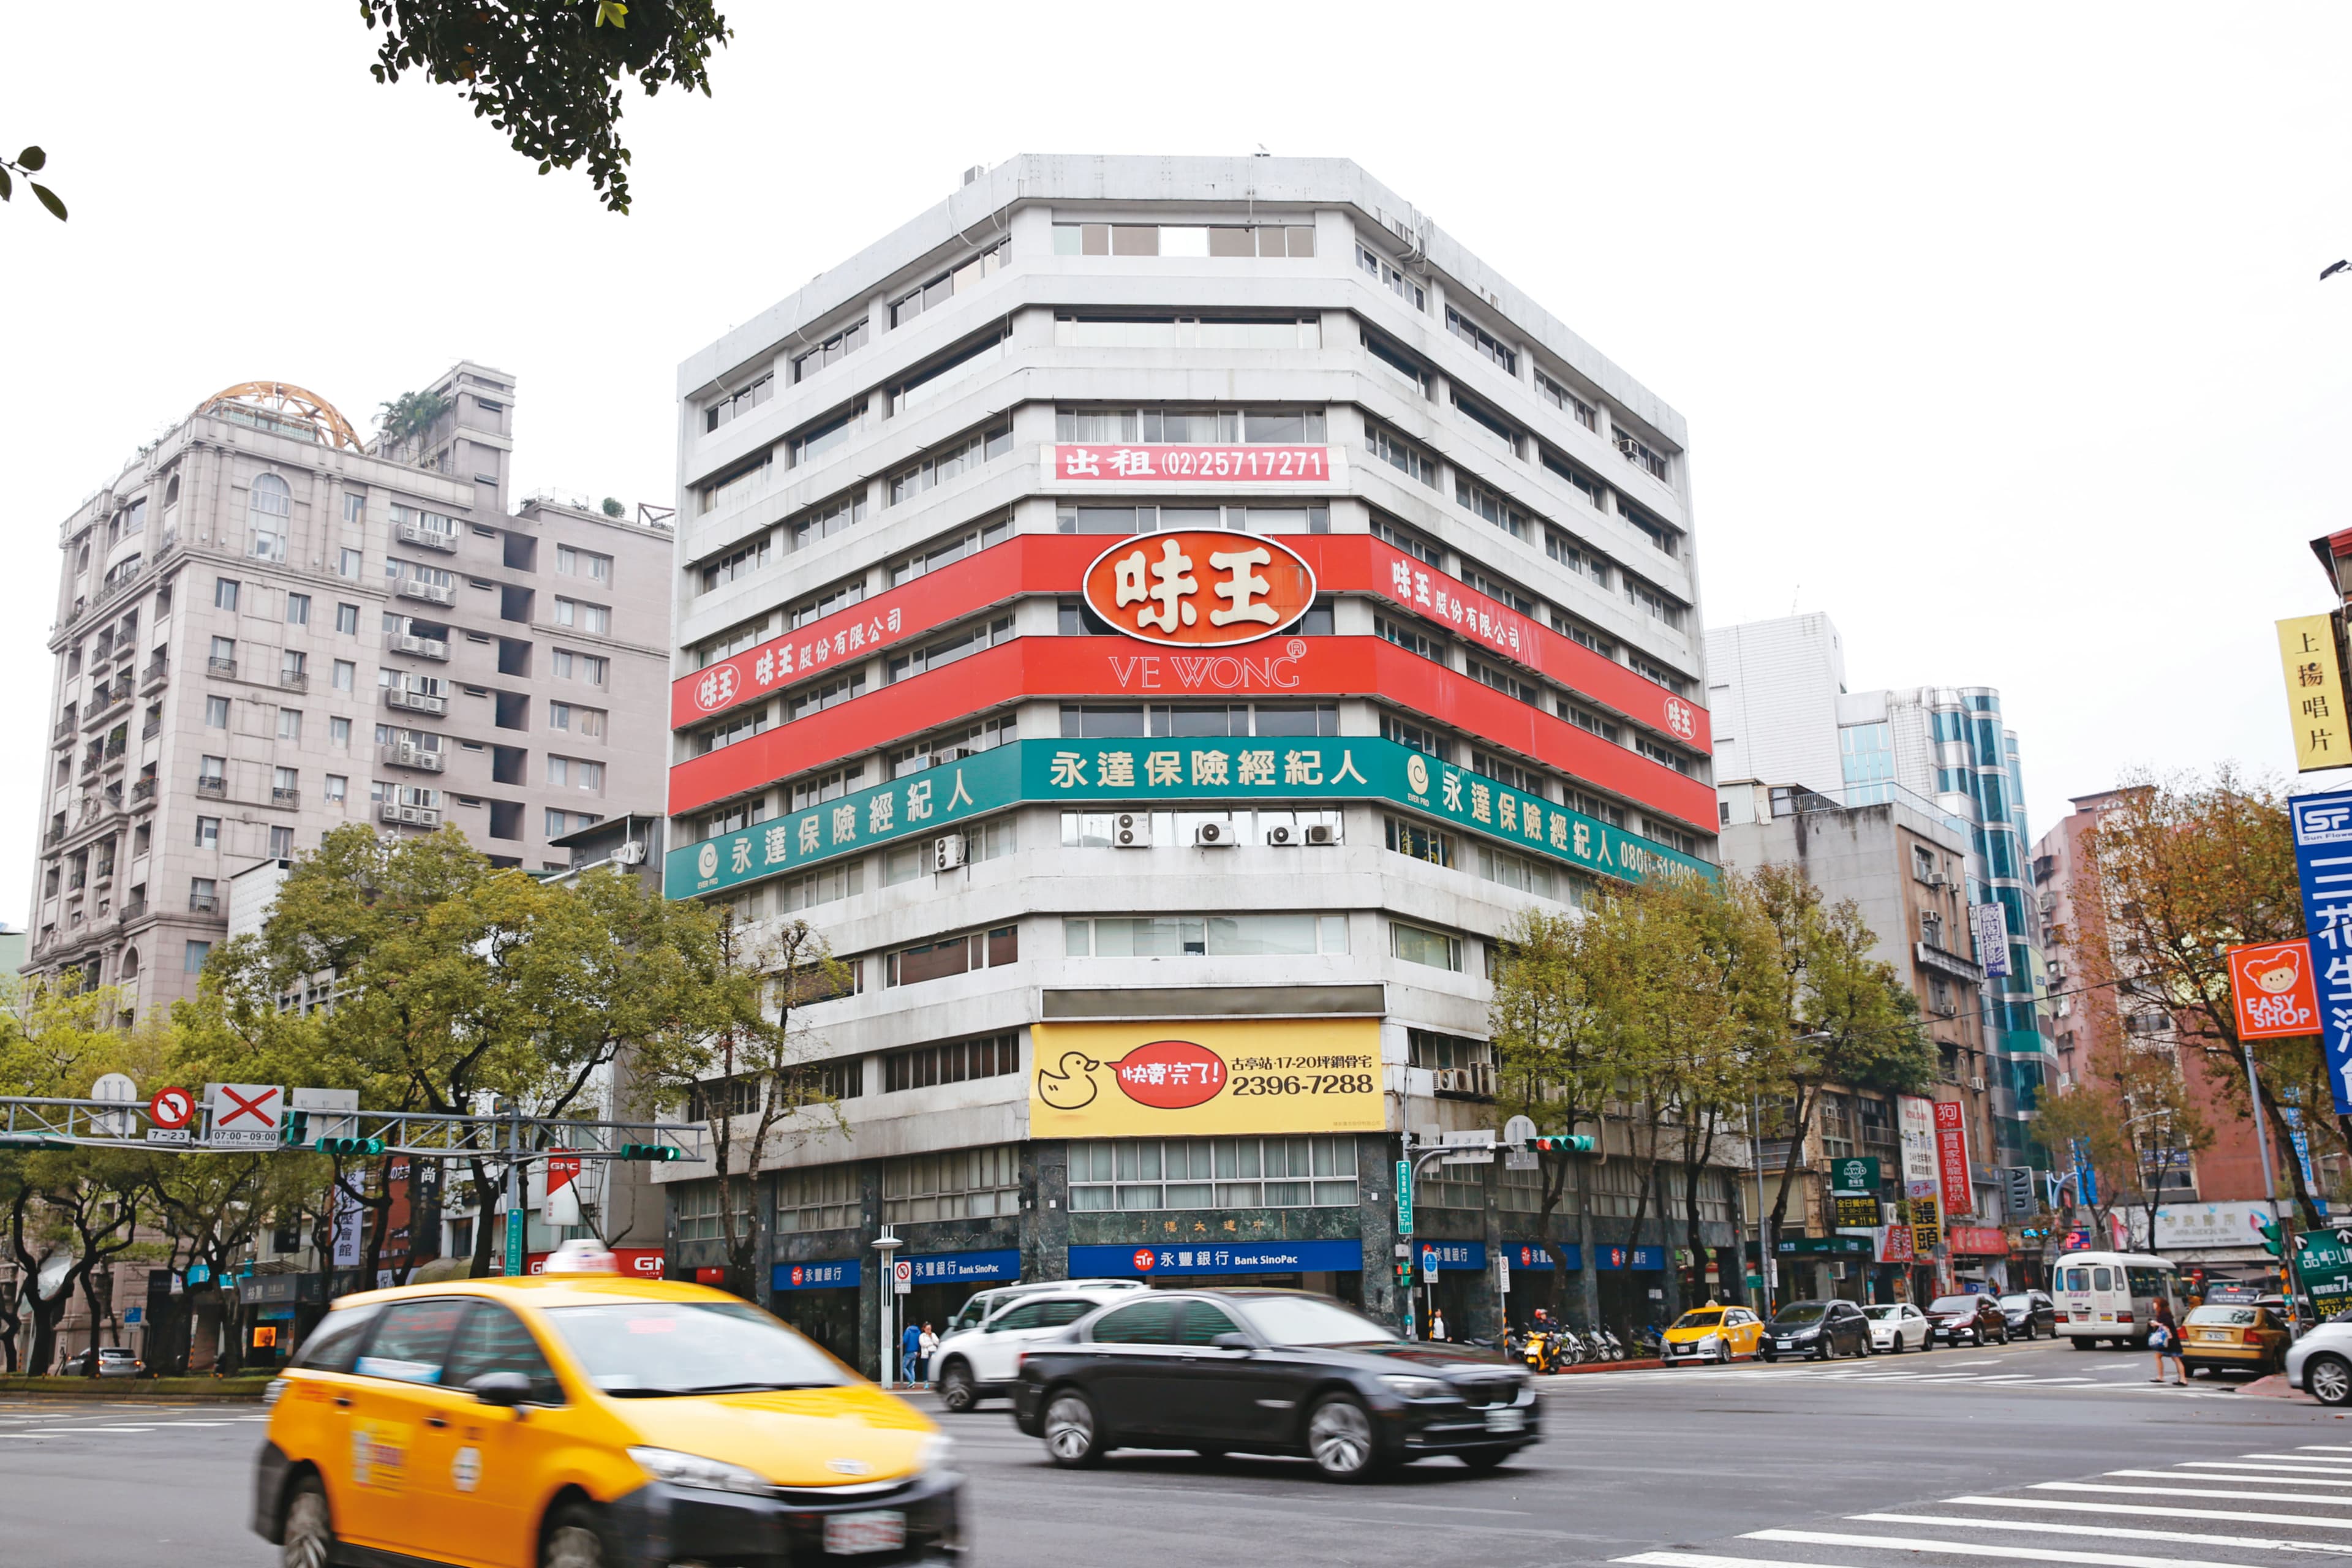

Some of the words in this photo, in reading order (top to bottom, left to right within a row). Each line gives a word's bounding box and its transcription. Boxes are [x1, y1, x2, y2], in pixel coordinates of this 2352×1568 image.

[1065, 448, 1156, 477] 出租
[1161, 451, 1321, 477] (02)25717271
[1114, 538, 1280, 633] 味王
[1109, 657, 1161, 688] VE
[1170, 657, 1299, 688] WONG
[699, 668, 734, 707] 味王
[2295, 633, 2332, 752] 上揚唱片
[1668, 700, 1692, 736] 味王
[1050, 749, 1368, 788] 永達保險經紀人
[1408, 793, 1420, 804] EVER
[731, 769, 973, 874] 永達保險經紀人
[1442, 771, 1613, 867] 永達保險經紀人
[2304, 807, 2350, 832] SF
[2245, 994, 2296, 1014] EASY
[2253, 1008, 2310, 1028] SHOP
[1121, 1061, 1219, 1085] 快賣完了!
[1232, 1073, 1374, 1096] 2396-7288
[1937, 1104, 1957, 1121] 狗
[550, 1162, 579, 1170] GNC
[1844, 1166, 1867, 1175] MWD
[634, 1257, 665, 1270] GN
[915, 1260, 957, 1277] 永豐銀行
[959, 1265, 974, 1275] Bank
[974, 1264, 999, 1273] SinoPac
[1159, 1250, 1229, 1267] 永豐銀行
[1234, 1256, 1258, 1265] Bank
[1260, 1254, 1298, 1265] SinoPac
[805, 1266, 842, 1283] 永豐銀行
